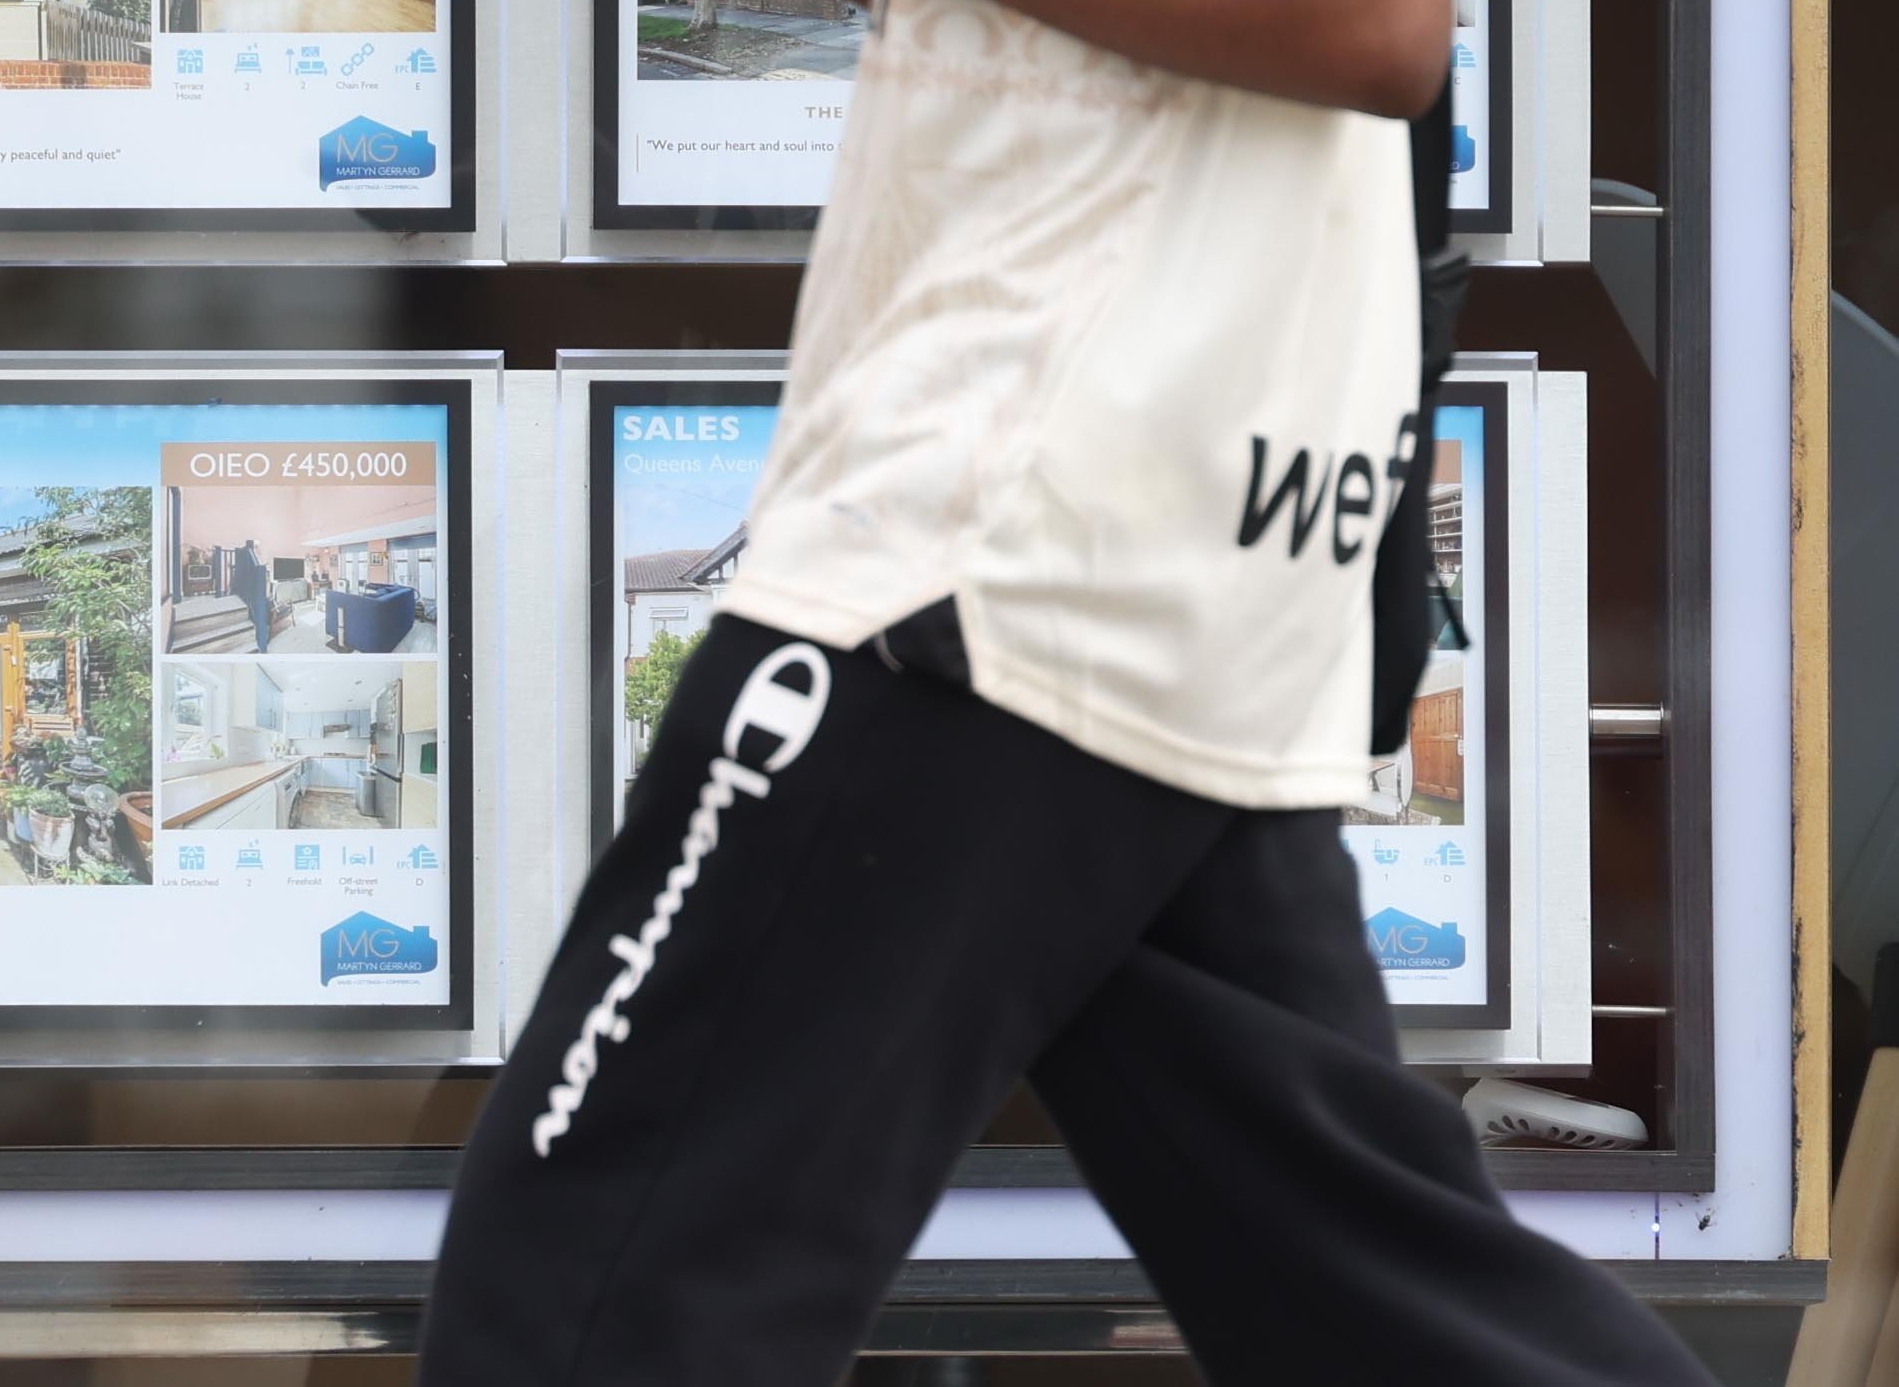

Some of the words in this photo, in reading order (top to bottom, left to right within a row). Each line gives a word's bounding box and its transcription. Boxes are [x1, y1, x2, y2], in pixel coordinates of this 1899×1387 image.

[173, 81, 205, 90] Terrace
[335, 80, 359, 90] Chain
[360, 80, 379, 91] Free
[175, 92, 202, 101] House
[805, 107, 842, 118] THE
[336, 133, 398, 163] MG
[678, 142, 696, 153] put
[700, 142, 722, 151] our
[725, 139, 756, 151] heart
[760, 140, 780, 151] and
[784, 140, 807, 151] soul
[812, 141, 834, 152] into
[11, 149, 58, 162] peaceful
[62, 149, 82, 160] and
[335, 166, 377, 176] MARTYN
[377, 166, 422, 176] GERRARD
[622, 416, 740, 440] SALES
[190, 453, 270, 478] OIEO
[282, 452, 407, 480] £450,000
[624, 454, 701, 474] Queens
[709, 454, 764, 472] Aven
[161, 878, 179, 887] Link
[180, 877, 220, 887] Detached
[286, 876, 323, 886] Freehold
[338, 876, 379, 886] Off-street
[343, 887, 374, 897] Parking
[532, 640, 833, 1158] Champion
[338, 928, 398, 958] MG
[337, 961, 378, 972] MARTYN
[378, 961, 423, 972] GERRARD
[1376, 957, 1407, 967] RTYN
[1407, 957, 1451, 967] GERRARD
